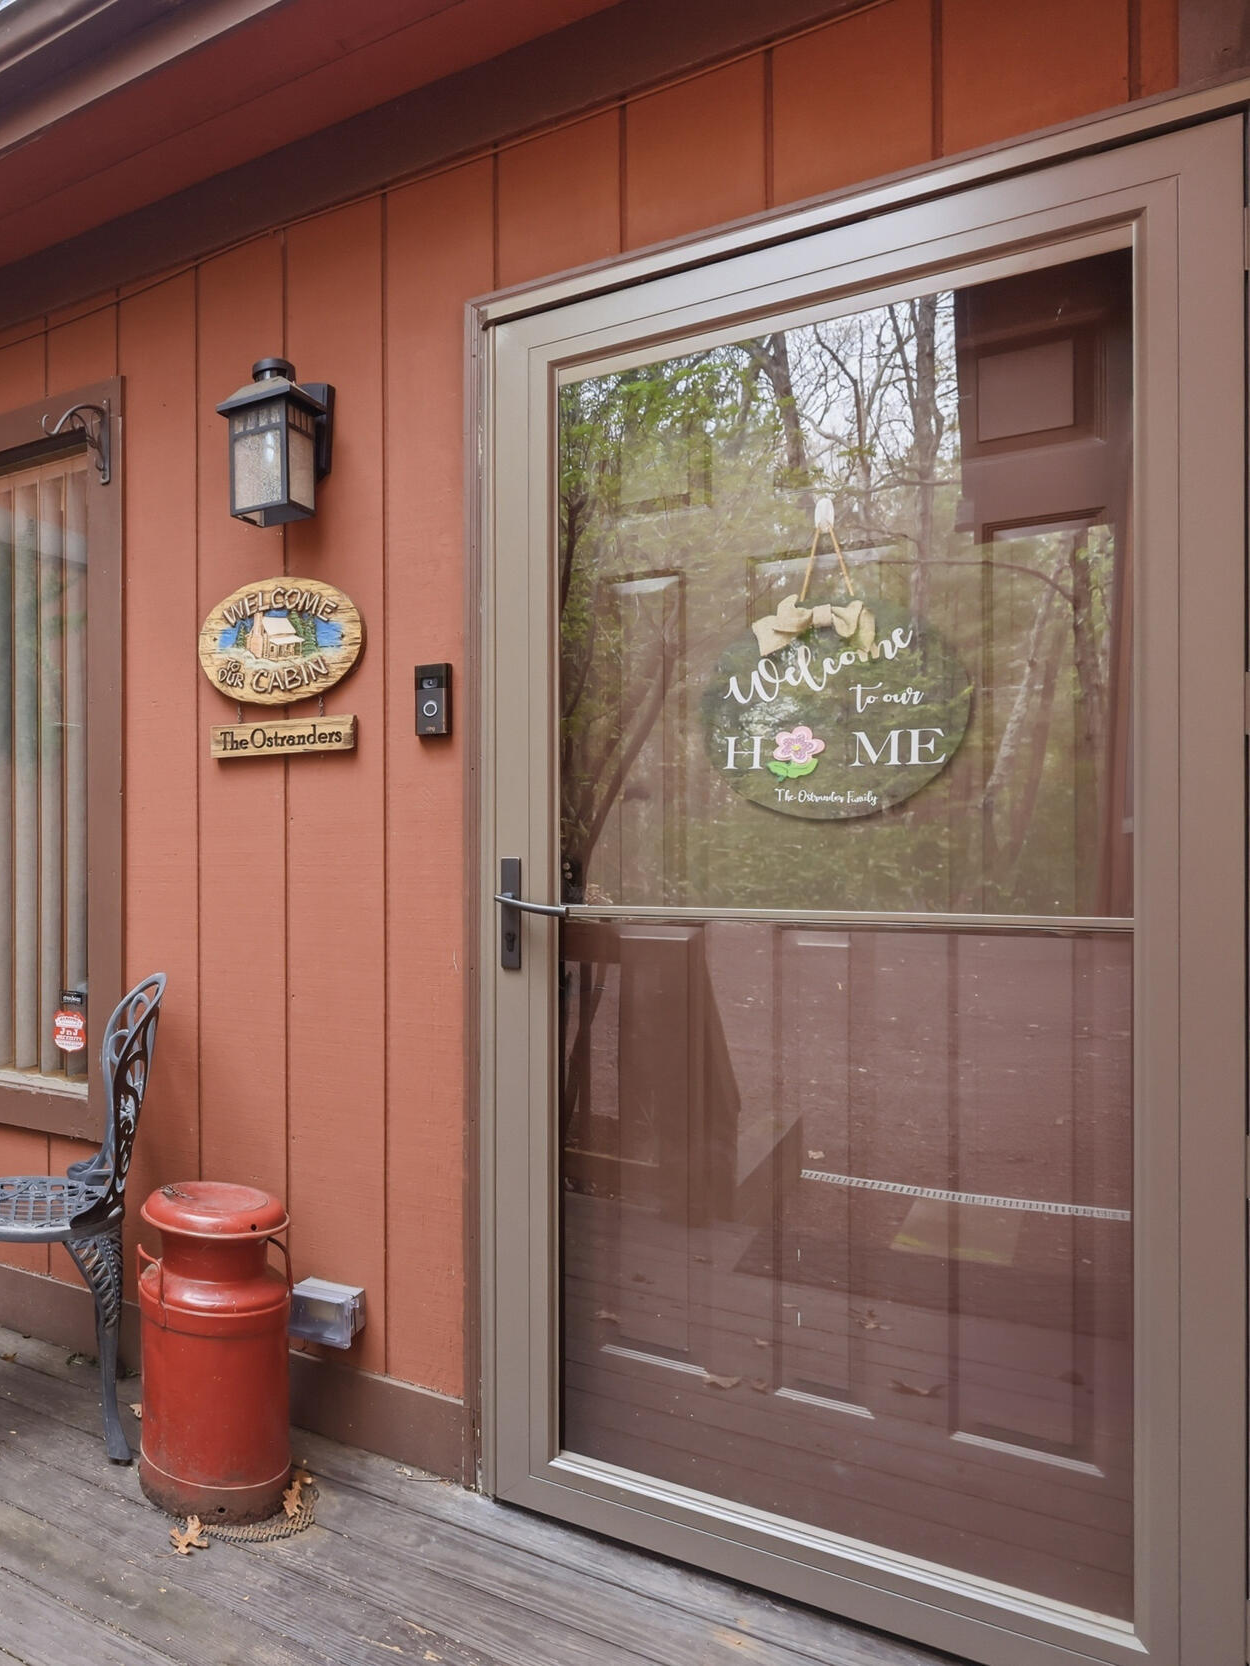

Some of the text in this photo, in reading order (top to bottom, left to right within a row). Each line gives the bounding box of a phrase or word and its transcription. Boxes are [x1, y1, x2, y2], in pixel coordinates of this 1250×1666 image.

[222, 587, 337, 626] WELCOME
[218, 668, 245, 688] OUR
[225, 658, 240, 672] TO
[252, 656, 329, 694] CABIN
[849, 682, 924, 713] to our
[220, 724, 343, 751] The Ostranders
